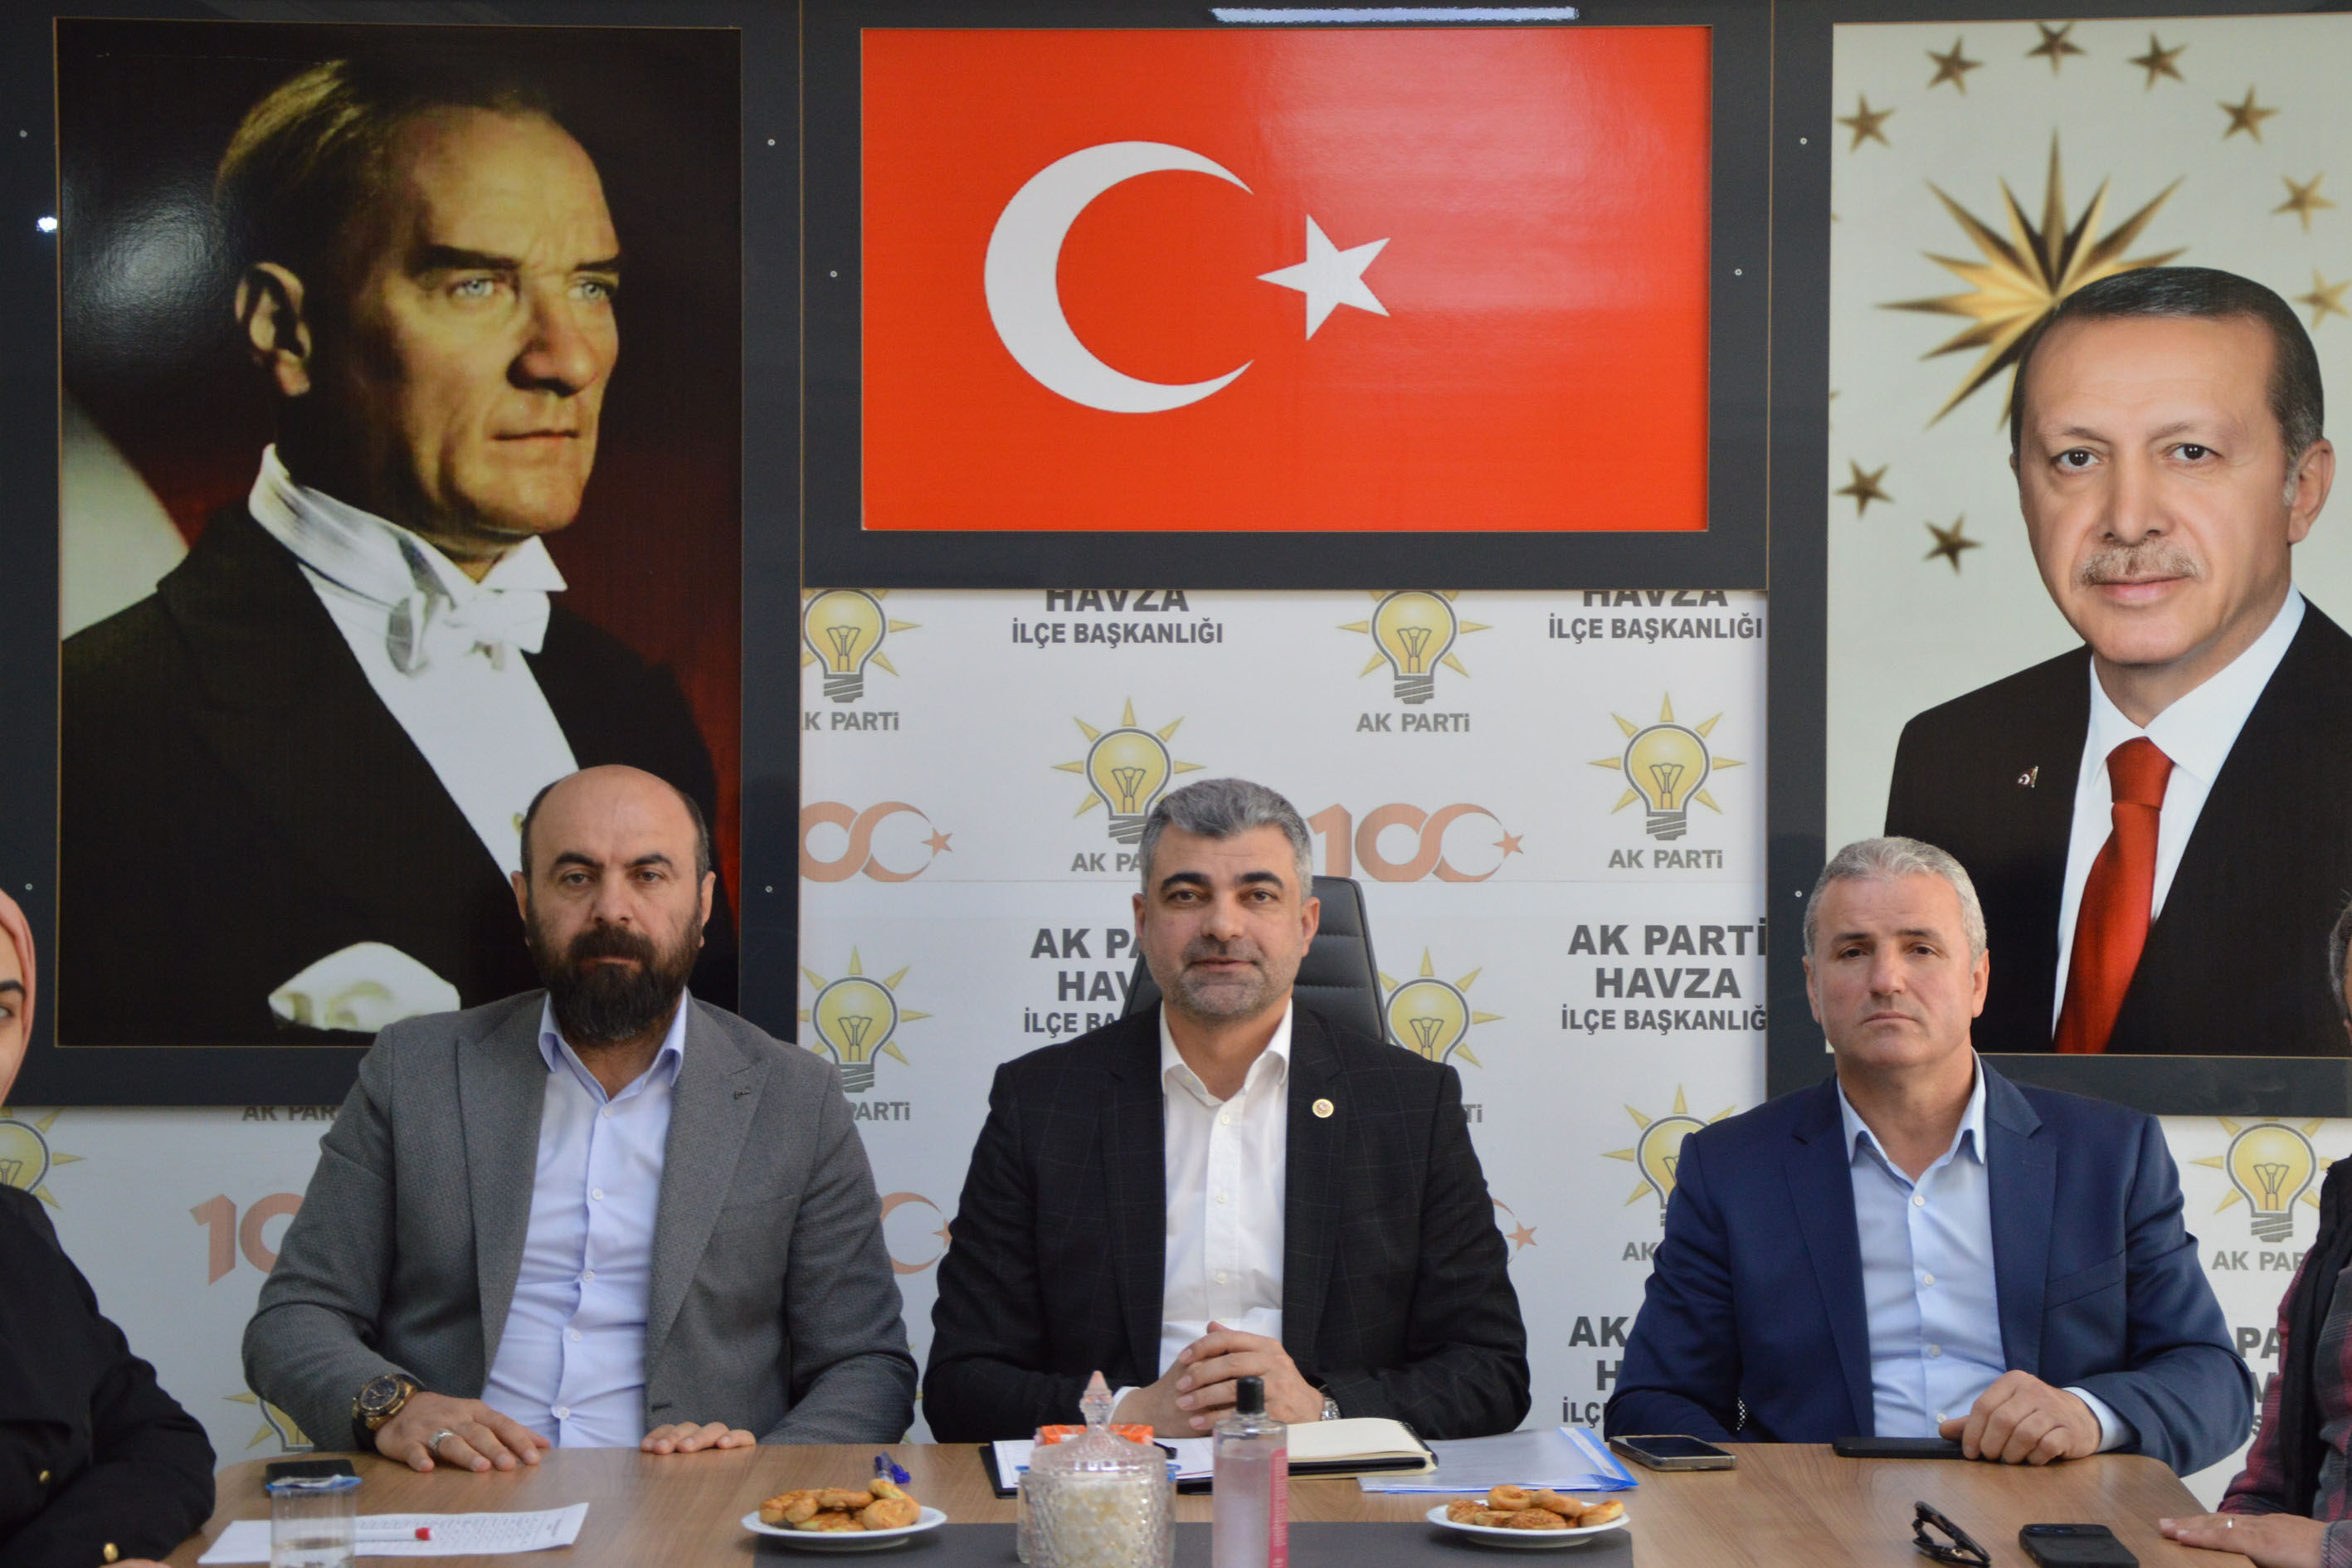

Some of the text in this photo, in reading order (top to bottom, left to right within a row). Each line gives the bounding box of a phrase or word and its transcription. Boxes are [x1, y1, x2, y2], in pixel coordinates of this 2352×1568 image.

[1045, 590, 1190, 612] HAVZA
[1012, 617, 1224, 649] İLÇE BAŞKANLIĞI
[1549, 611, 1762, 644] İLÇE BAŞKANLIĞI
[802, 711, 821, 731] K
[1356, 713, 1392, 733] AK
[1070, 852, 1107, 872] AK
[1608, 849, 1643, 869] AK
[1030, 928, 1092, 959] AK
[1567, 917, 1766, 956] AK PARTİ
[1595, 967, 1741, 999] HAVZA
[1024, 1006, 1079, 1039] İLÇE
[1561, 1003, 1767, 1035] İLÇE BAŞKANLIĞ
[241, 1105, 338, 1121] AK PAR
[1622, 1241, 1656, 1262] AK
[2211, 1250, 2249, 1271] AK
[1568, 1316, 1629, 1348] AK
